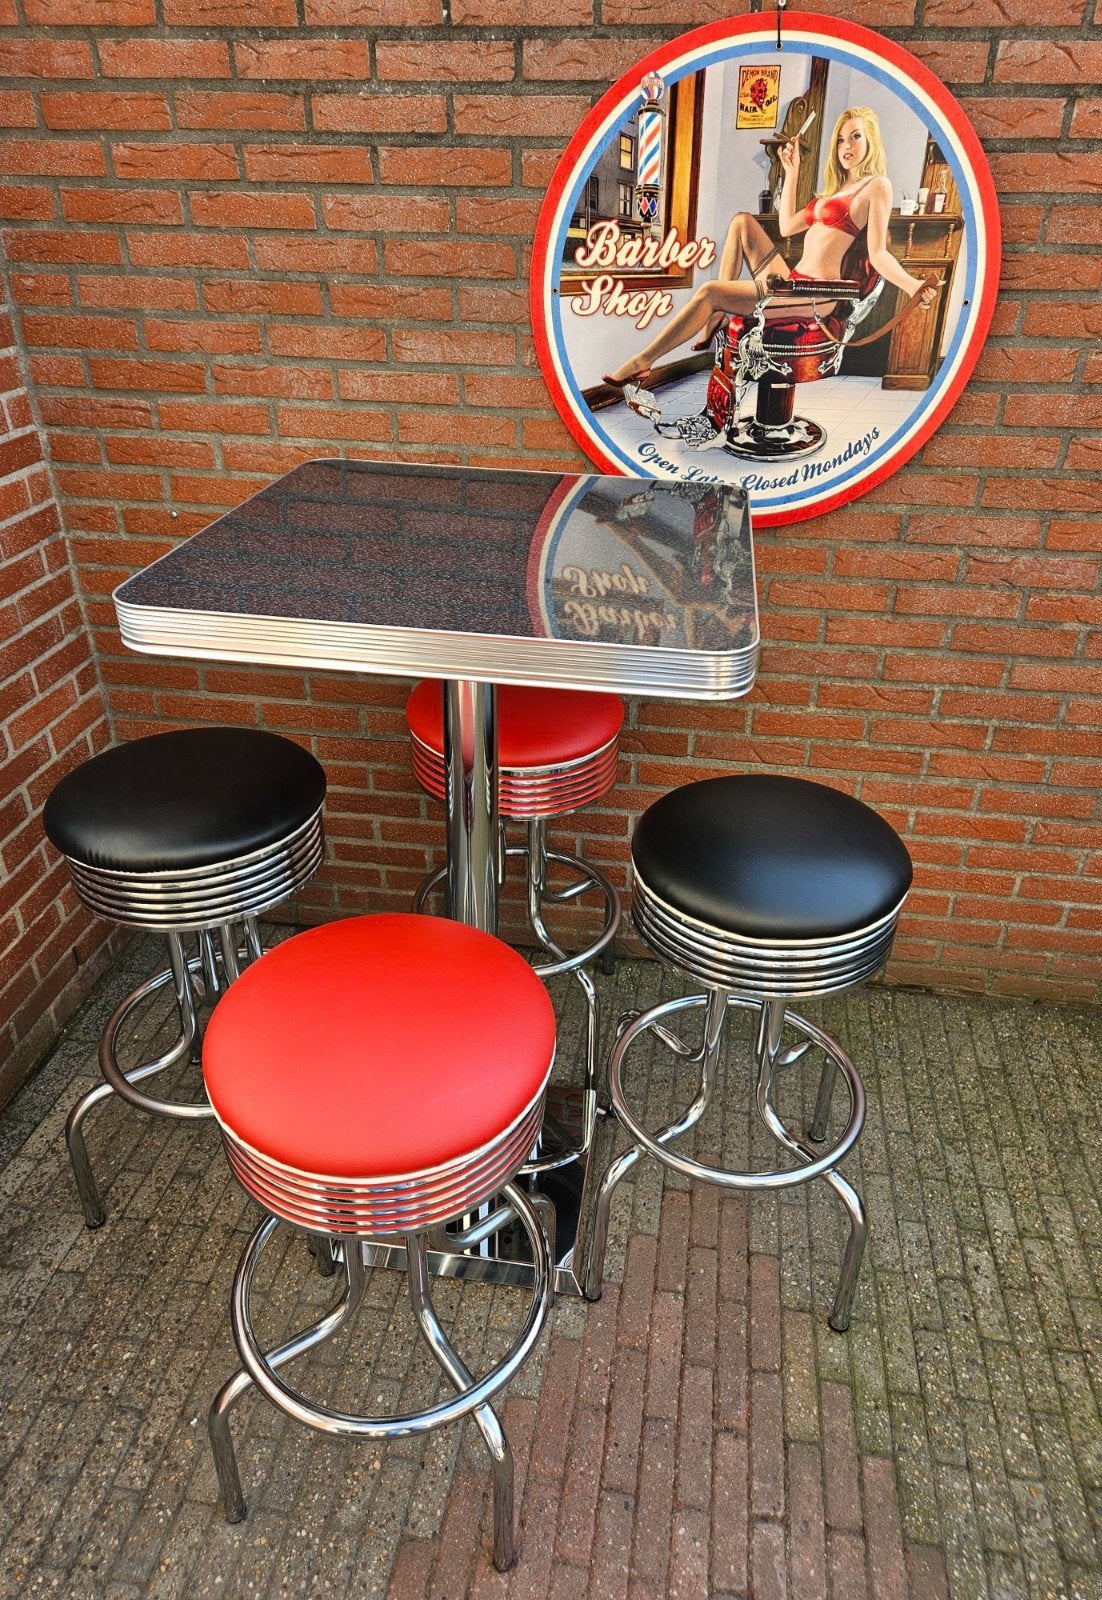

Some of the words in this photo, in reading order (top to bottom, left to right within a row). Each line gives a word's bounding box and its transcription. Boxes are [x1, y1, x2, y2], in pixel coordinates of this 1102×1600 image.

[741, 69, 760, 88] DEMON
[740, 102, 757, 113] HAIR
[575, 219, 717, 269] Barber
[571, 274, 673, 330] Shop
[638, 442, 679, 475] Open
[740, 469, 798, 491] Closed
[801, 426, 880, 482] Mondays
